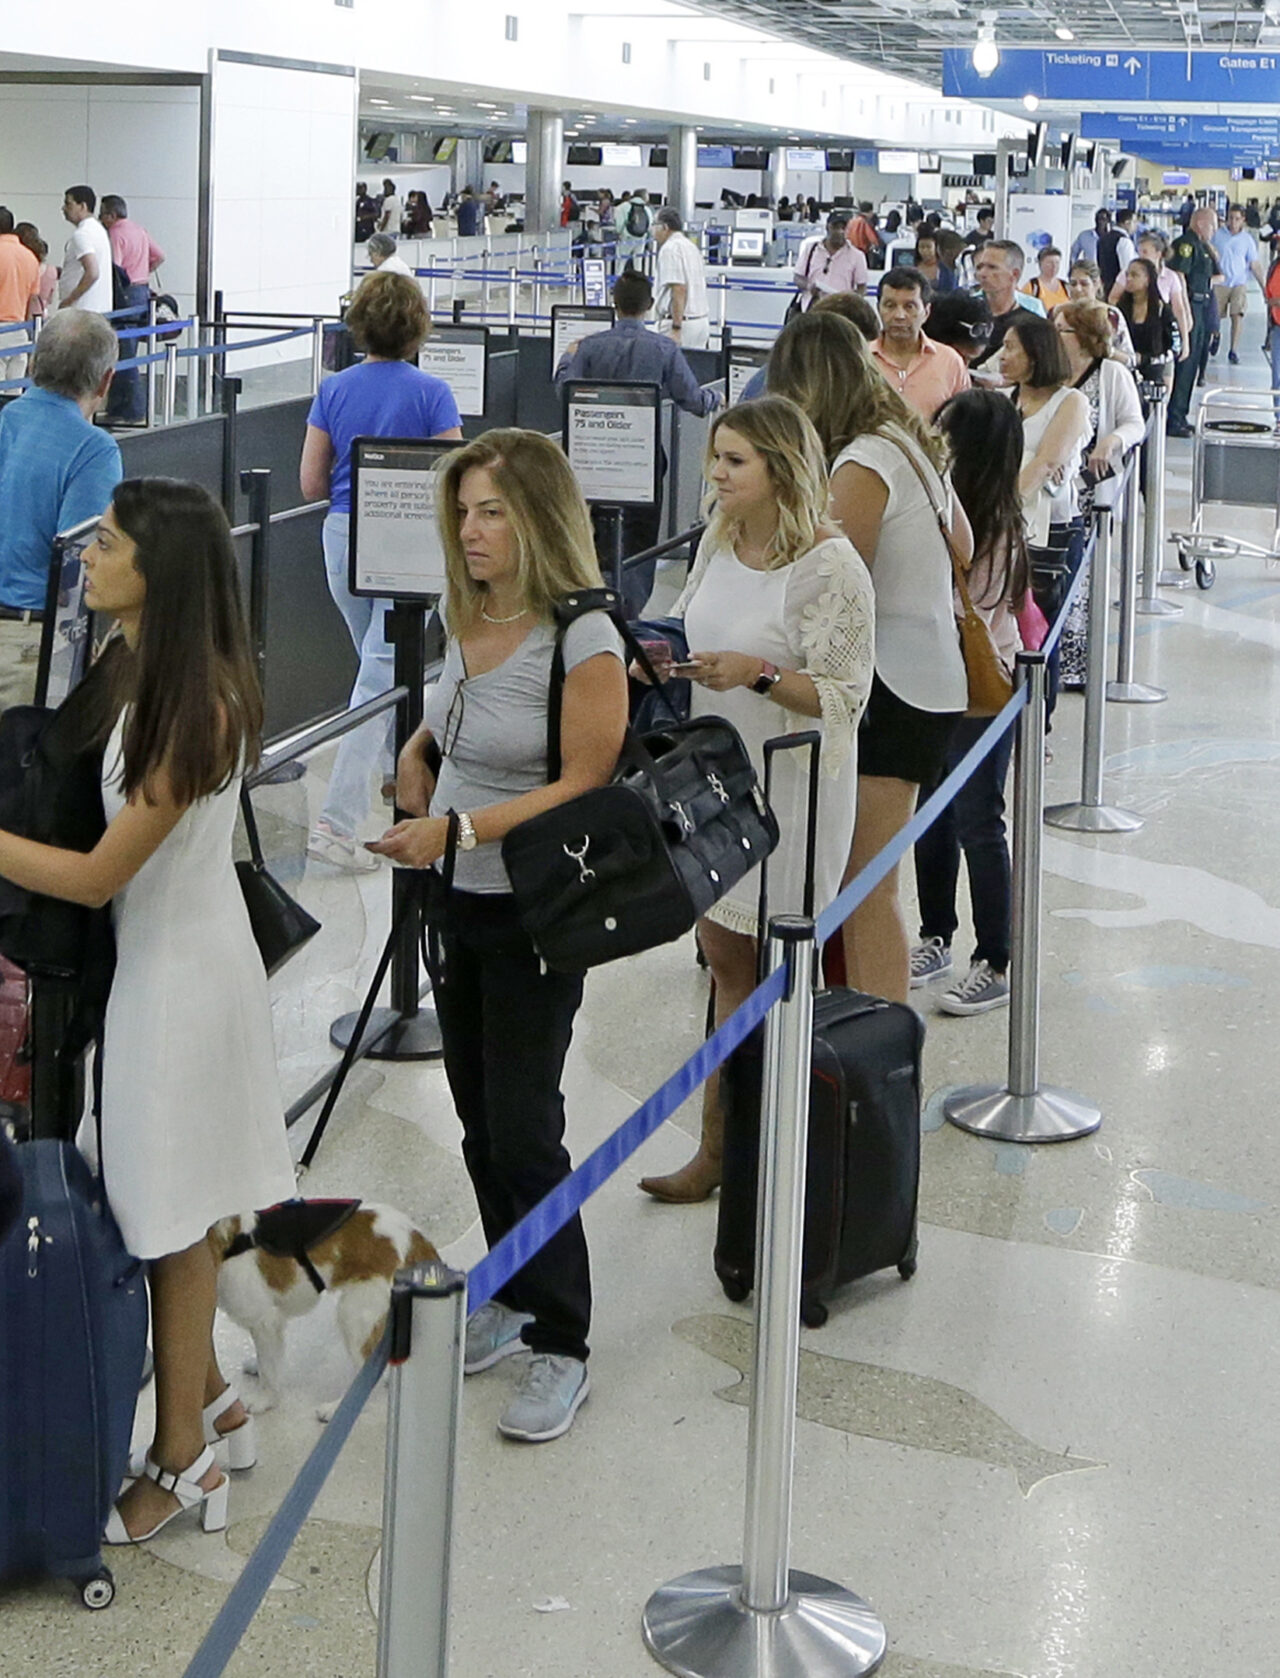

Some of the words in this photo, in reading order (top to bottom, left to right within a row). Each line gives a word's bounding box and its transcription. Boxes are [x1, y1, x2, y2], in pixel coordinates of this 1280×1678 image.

[1046, 53, 1101, 67] Ticketing
[1219, 56, 1257, 69] Gates
[574, 409, 625, 420] Passengers
[574, 419, 586, 428] 75
[588, 420, 605, 428] and
[607, 421, 632, 429] Older
[364, 480, 379, 488] You
[364, 488, 387, 498] where
[364, 501, 397, 509] property
[364, 511, 401, 519] additional
